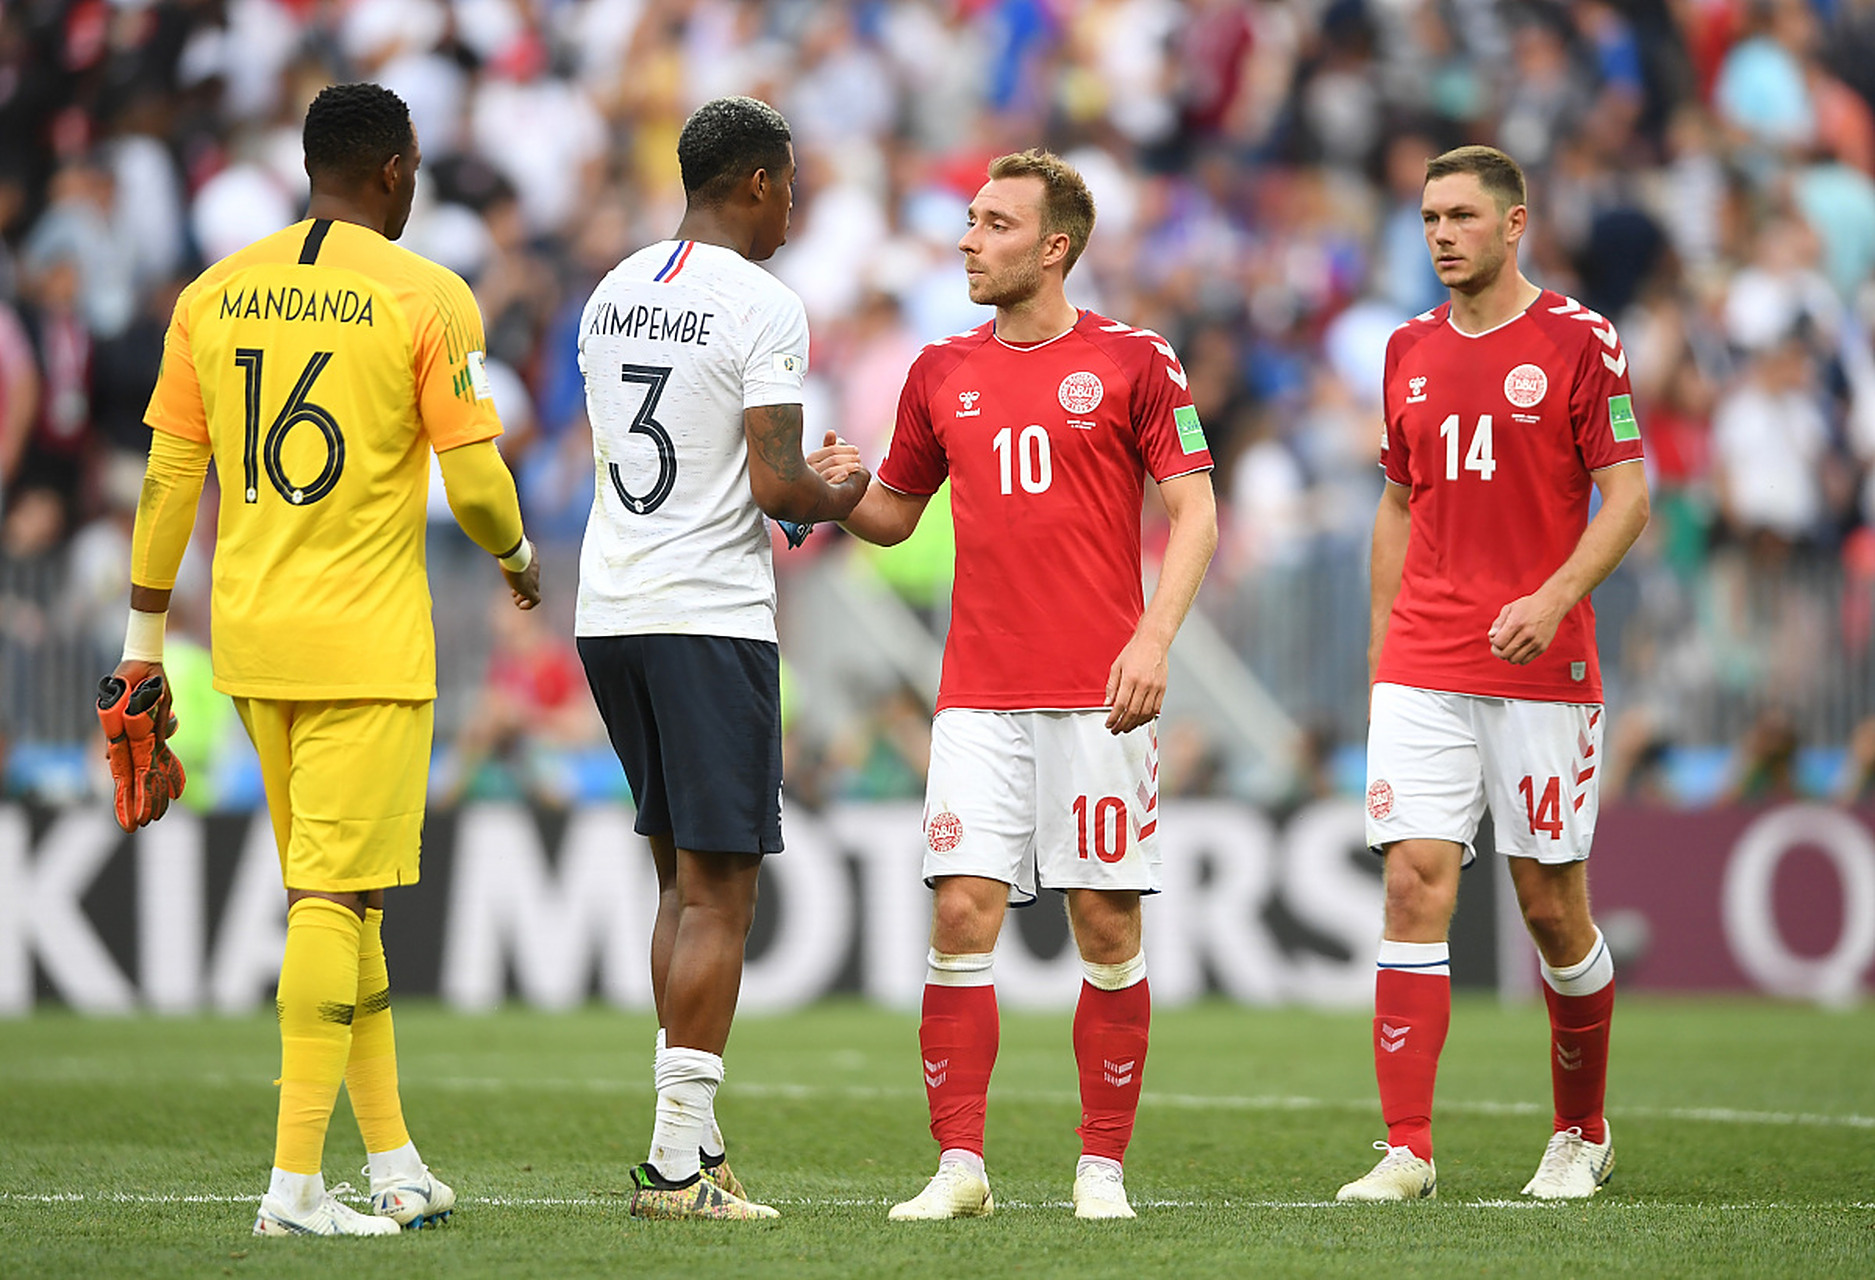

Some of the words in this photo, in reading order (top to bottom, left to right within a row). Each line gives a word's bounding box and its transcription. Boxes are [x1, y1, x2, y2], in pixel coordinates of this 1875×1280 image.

[219, 286, 375, 328] MANDANDA
[234, 347, 346, 507] 16
[608, 363, 678, 516] 3
[992, 424, 1053, 495] 10
[1440, 413, 1497, 481] 14
[1071, 794, 1128, 864] 10
[1518, 775, 1564, 841] 14
[438, 797, 1386, 1018] MOTRS
[1721, 803, 1875, 1012] Q
